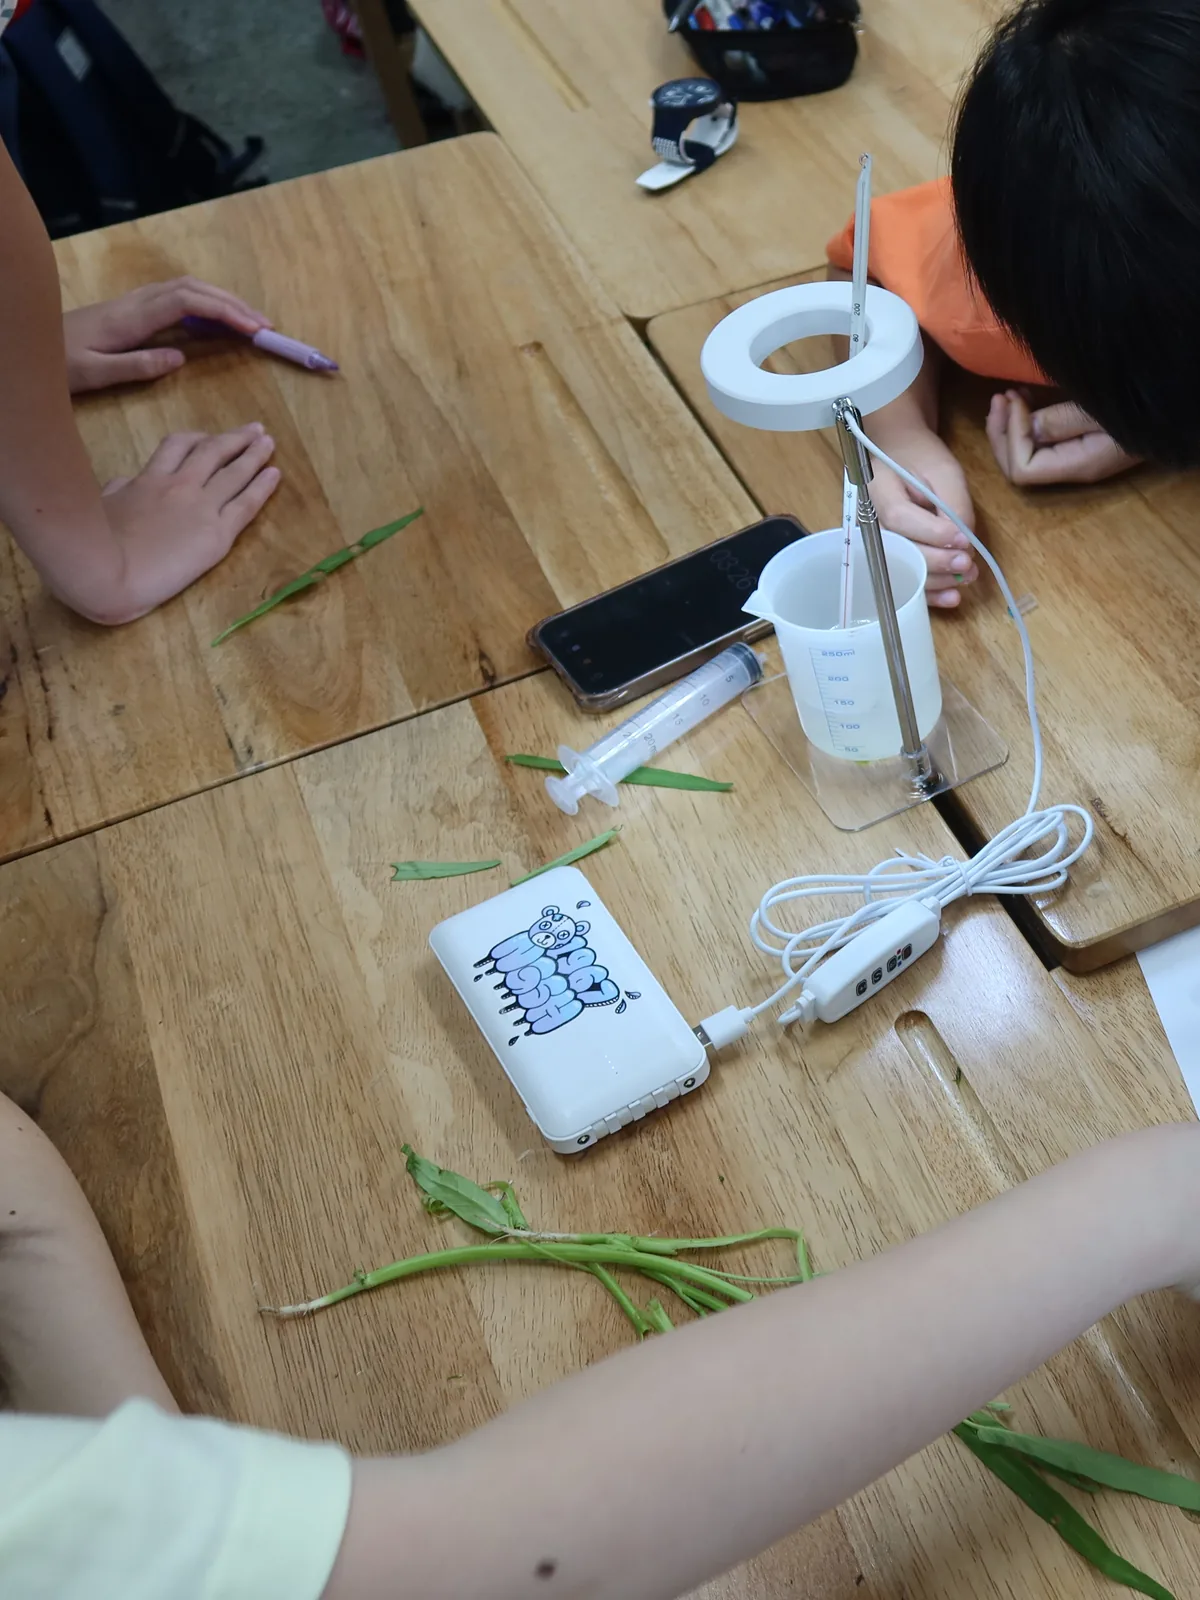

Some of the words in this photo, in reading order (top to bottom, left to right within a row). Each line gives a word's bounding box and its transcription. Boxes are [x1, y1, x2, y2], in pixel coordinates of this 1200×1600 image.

[821, 649, 856, 657] 250ml
[725, 674, 735, 683] 5
[700, 693, 711, 707] 10
